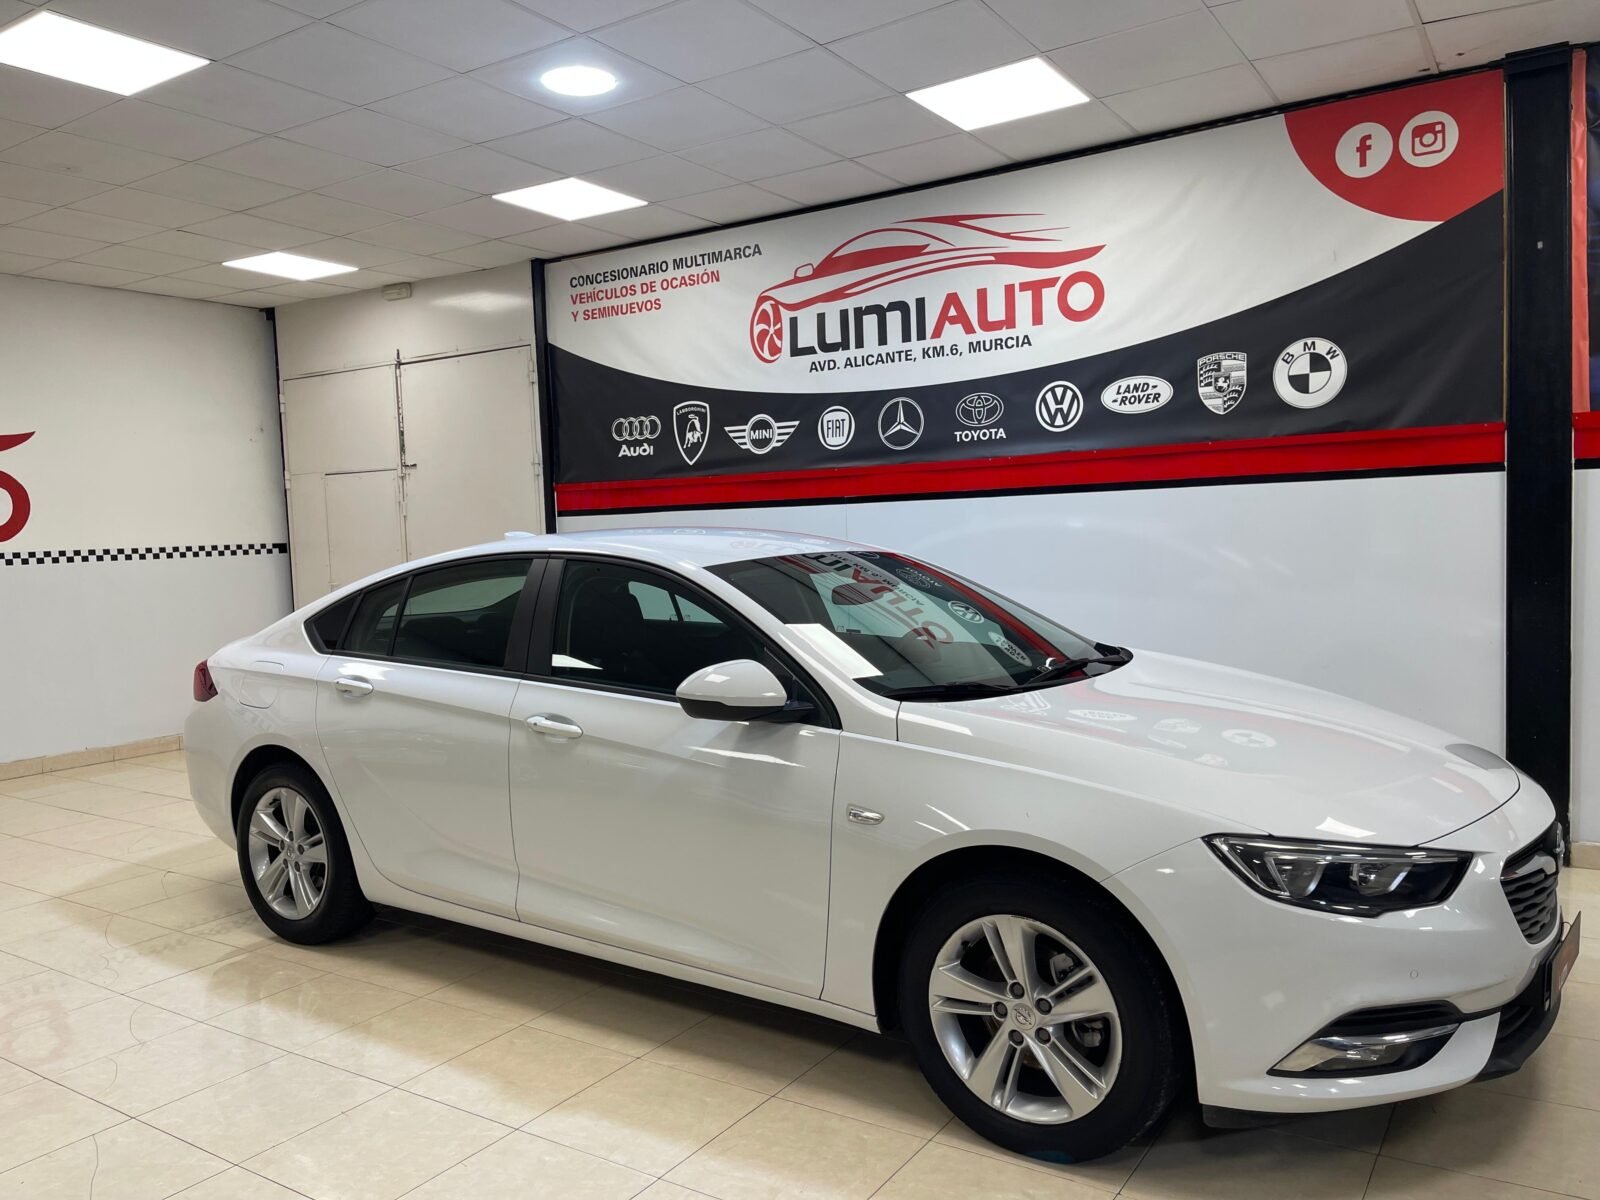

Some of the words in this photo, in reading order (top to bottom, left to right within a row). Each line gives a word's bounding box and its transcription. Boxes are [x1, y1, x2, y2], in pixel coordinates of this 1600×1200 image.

[569, 260, 669, 289] CONCESIONARIO
[672, 243, 762, 270] MULTIMARCA
[570, 284, 637, 306] VEHÍCULOS
[640, 281, 657, 295] DE
[660, 269, 721, 291] OCASIÓN
[571, 310, 579, 323] Y
[582, 298, 662, 321] SEMINUEVOS
[809, 357, 840, 373] AVD.
[843, 349, 917, 369] ALICANTE,
[922, 343, 964, 361] KM.6,
[968, 334, 1032, 354] MURCIA
[1199, 352, 1246, 366] PORSCHE
[1281, 340, 1340, 365] BMW
[676, 406, 706, 416] LAMBORGHINI
[750, 428, 773, 440] MINI
[826, 418, 846, 439] FIAT
[954, 428, 1006, 443] TOYOTA
[617, 443, 654, 458] Audi
